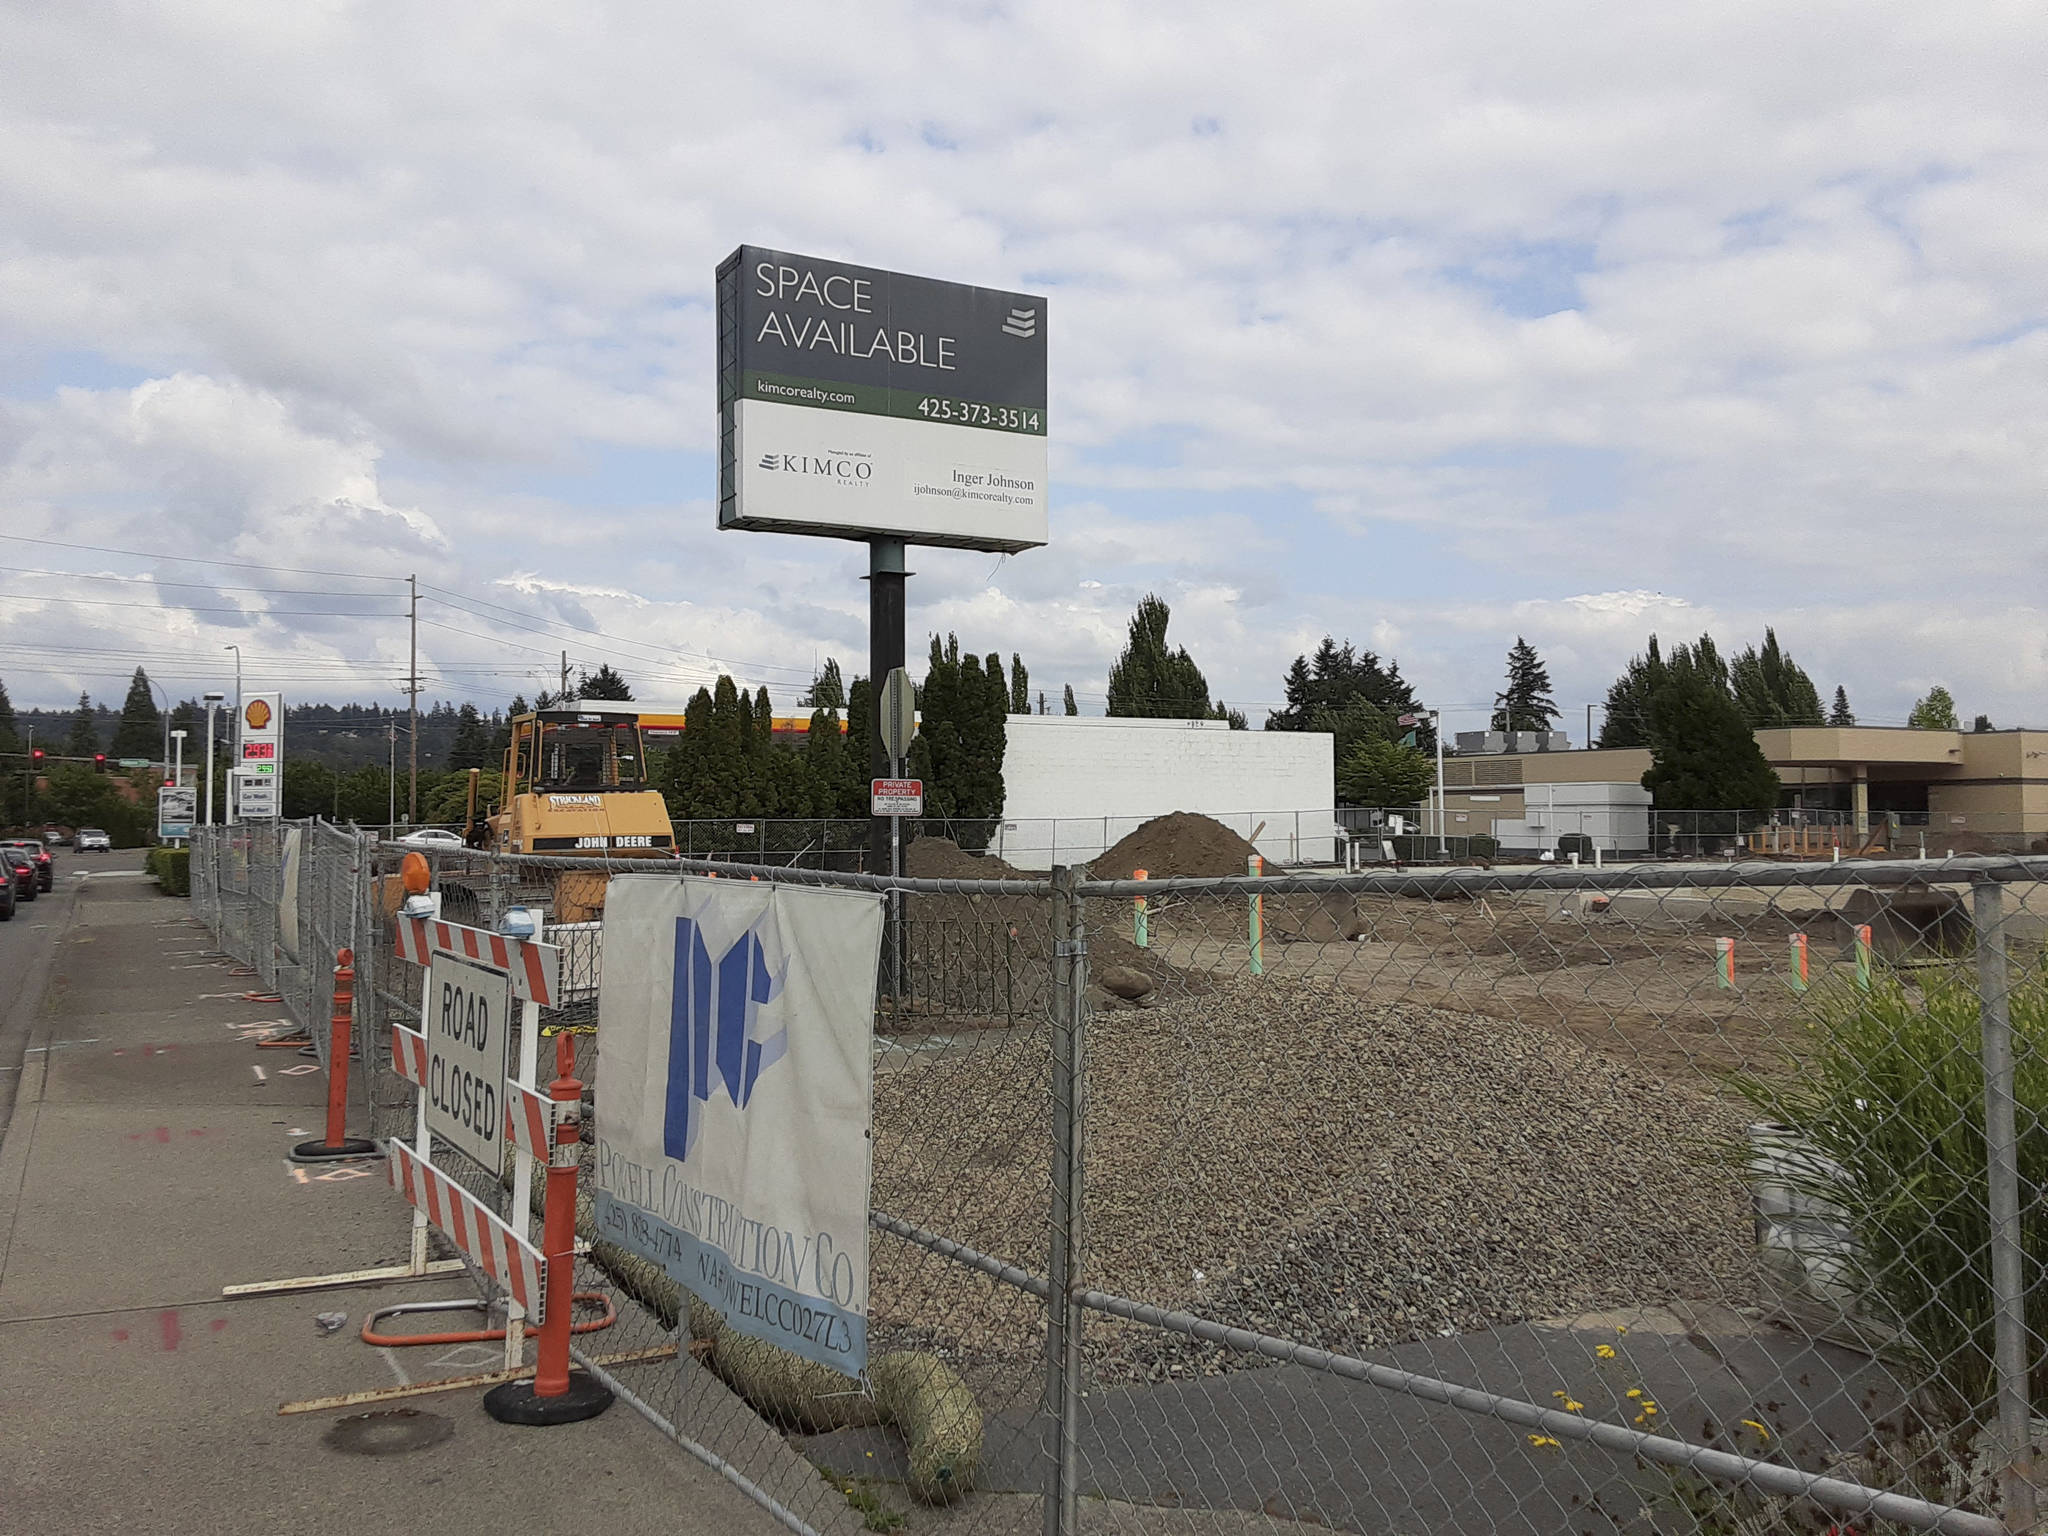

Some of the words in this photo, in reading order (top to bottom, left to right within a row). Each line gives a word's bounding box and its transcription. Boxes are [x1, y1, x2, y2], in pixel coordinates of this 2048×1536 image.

[756, 262, 873, 314] SPACE
[757, 311, 957, 371] AVAILABLE
[757, 379, 855, 404] kimcorealty.com
[917, 397, 1040, 431] 425-373-3514
[783, 454, 872, 480] KIMCO
[953, 469, 983, 487] Inger
[986, 473, 1034, 490] Johnson
[837, 479, 872, 487] REALTY
[913, 483, 1034, 506] ijohnson@kimcorealty.com
[882, 781, 912, 789] PRIVATE
[575, 837, 608, 849] JOHN
[616, 835, 652, 848] DEERE
[441, 982, 489, 1052] ROAD
[431, 1053, 496, 1141] CLOSED
[662, 1164, 811, 1290] CONSTRUTION
